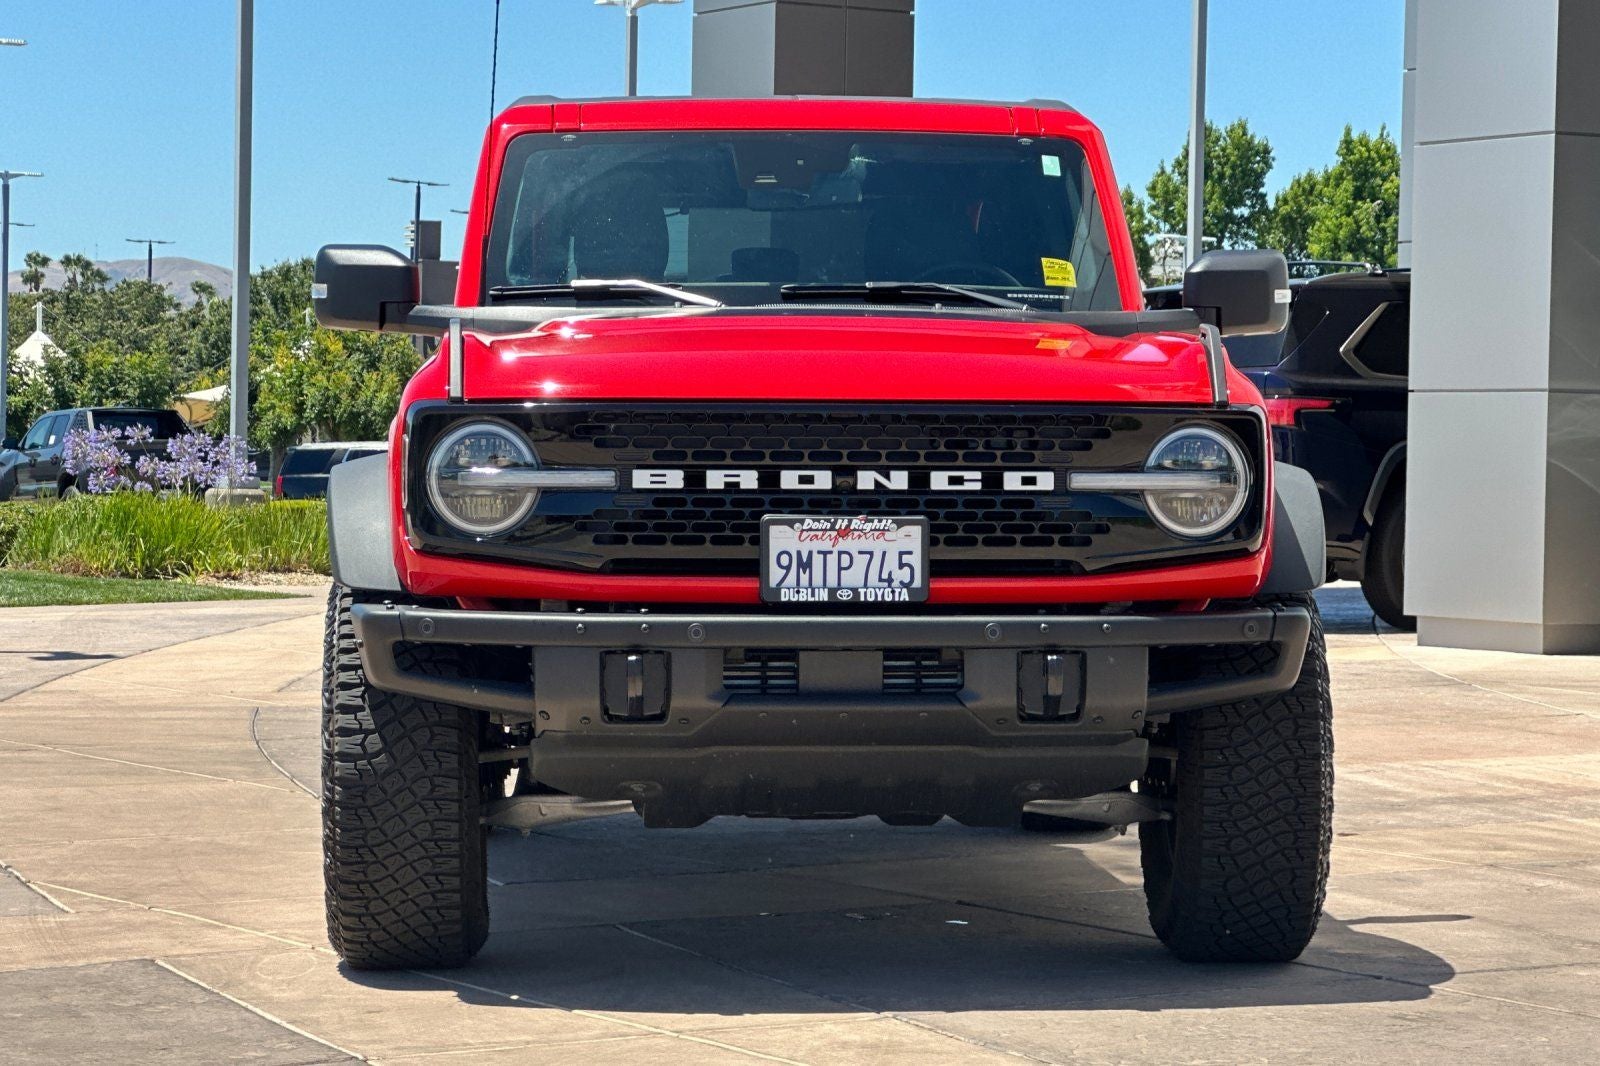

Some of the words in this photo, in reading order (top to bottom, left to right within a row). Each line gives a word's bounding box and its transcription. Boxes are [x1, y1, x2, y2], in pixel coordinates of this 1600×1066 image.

[632, 469, 1055, 490] BRONCO
[802, 518, 834, 530] Doin'
[835, 518, 849, 530] It
[850, 518, 893, 533] Right!
[775, 550, 915, 588] 9MTP745
[781, 588, 828, 602] DUBLIN
[858, 588, 909, 602] TOYOTA
